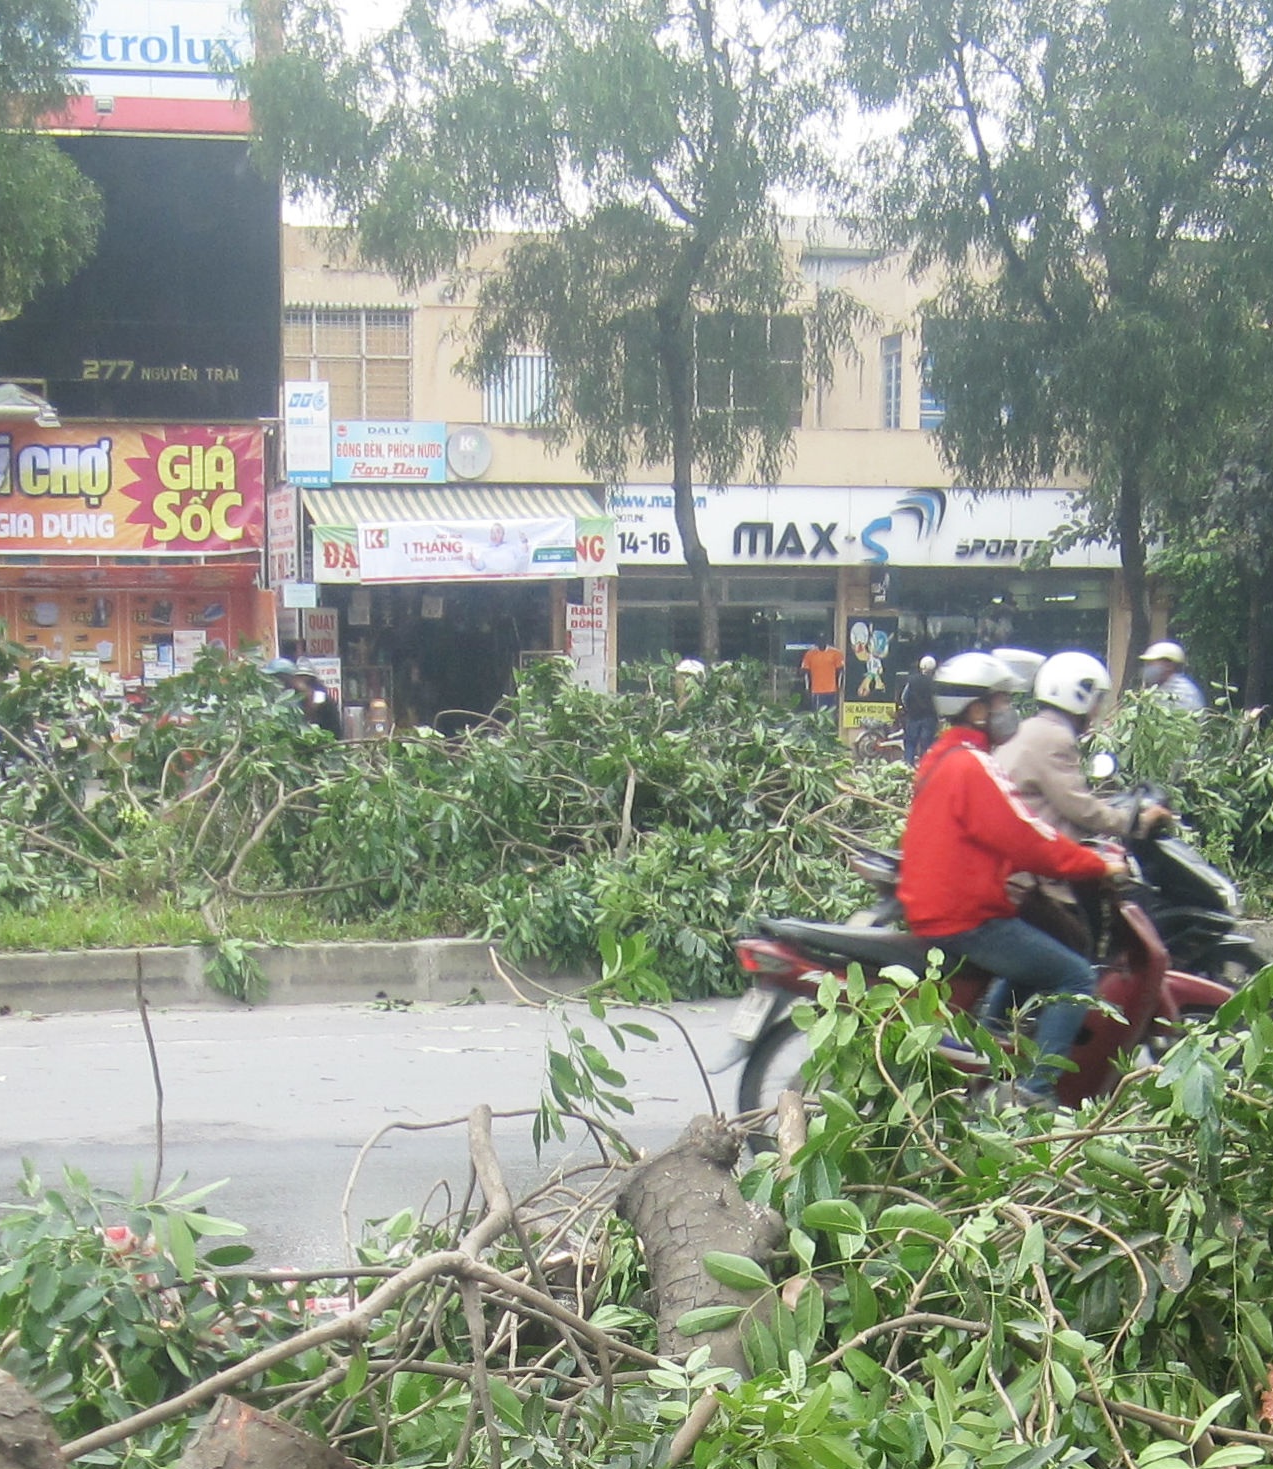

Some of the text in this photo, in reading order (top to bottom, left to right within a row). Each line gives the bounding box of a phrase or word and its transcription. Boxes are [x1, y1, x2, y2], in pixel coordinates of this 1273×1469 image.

[82, 359, 135, 380] 277
[18, 437, 112, 507] CHỢ
[157, 436, 236, 491] GIÁ
[42, 512, 115, 545] DỤNG
[152, 491, 243, 542] SỐC
[617, 532, 671, 555] 14-16
